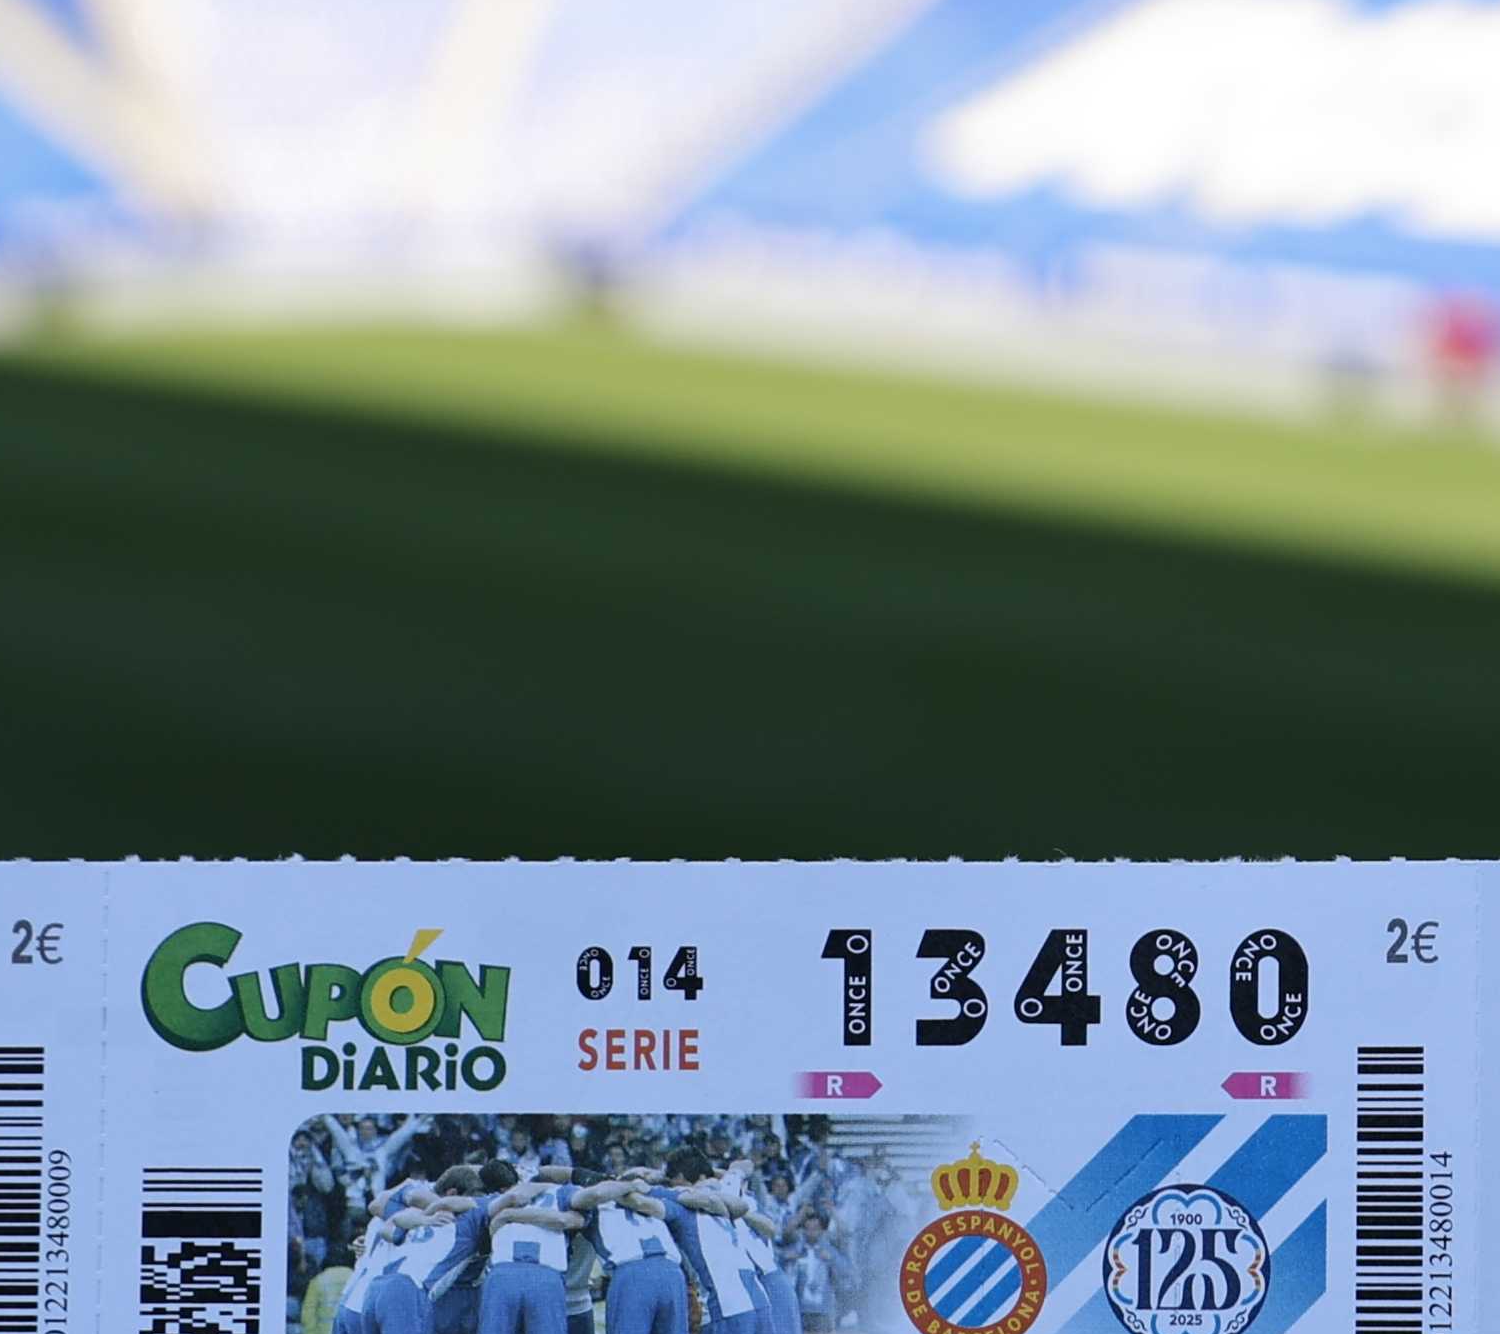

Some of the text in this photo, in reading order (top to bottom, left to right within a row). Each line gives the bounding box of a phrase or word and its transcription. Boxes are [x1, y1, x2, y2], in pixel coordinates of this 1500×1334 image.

[11, 919, 64, 965] 2€
[1386, 918, 1439, 964] 2€
[576, 946, 704, 1001] 014
[820, 928, 1309, 1047] 13480
[579, 1028, 701, 1072] SERIE
